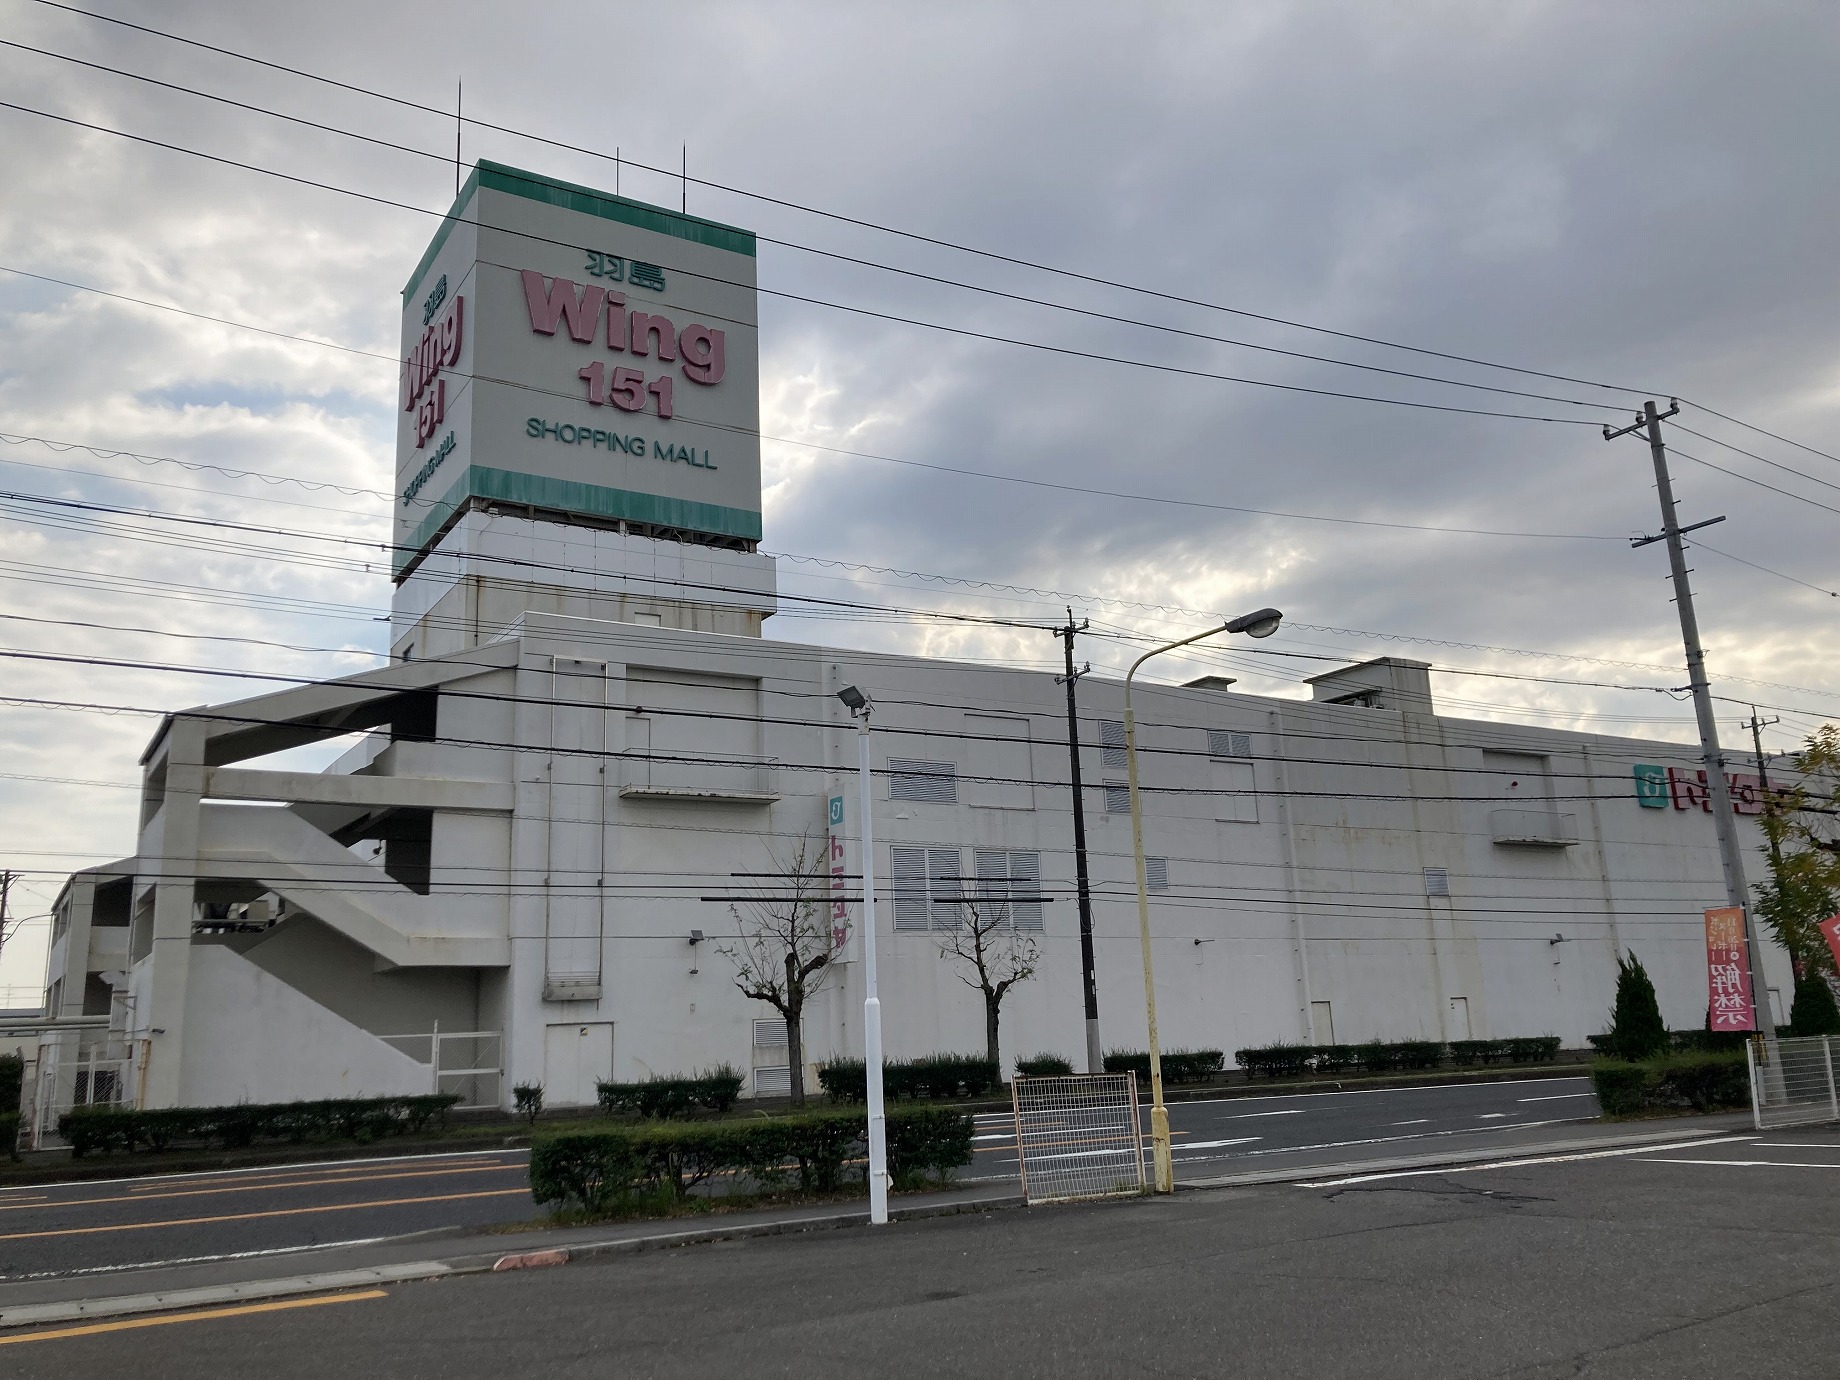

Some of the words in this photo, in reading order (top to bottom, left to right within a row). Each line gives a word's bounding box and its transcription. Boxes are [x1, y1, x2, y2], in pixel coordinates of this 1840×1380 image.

[584, 249, 666, 292] 羽島
[404, 295, 464, 411] Wing
[522, 269, 726, 385] Wing
[578, 361, 674, 419] 151
[526, 417, 646, 457] SHOPPING
[653, 440, 718, 470] MALL
